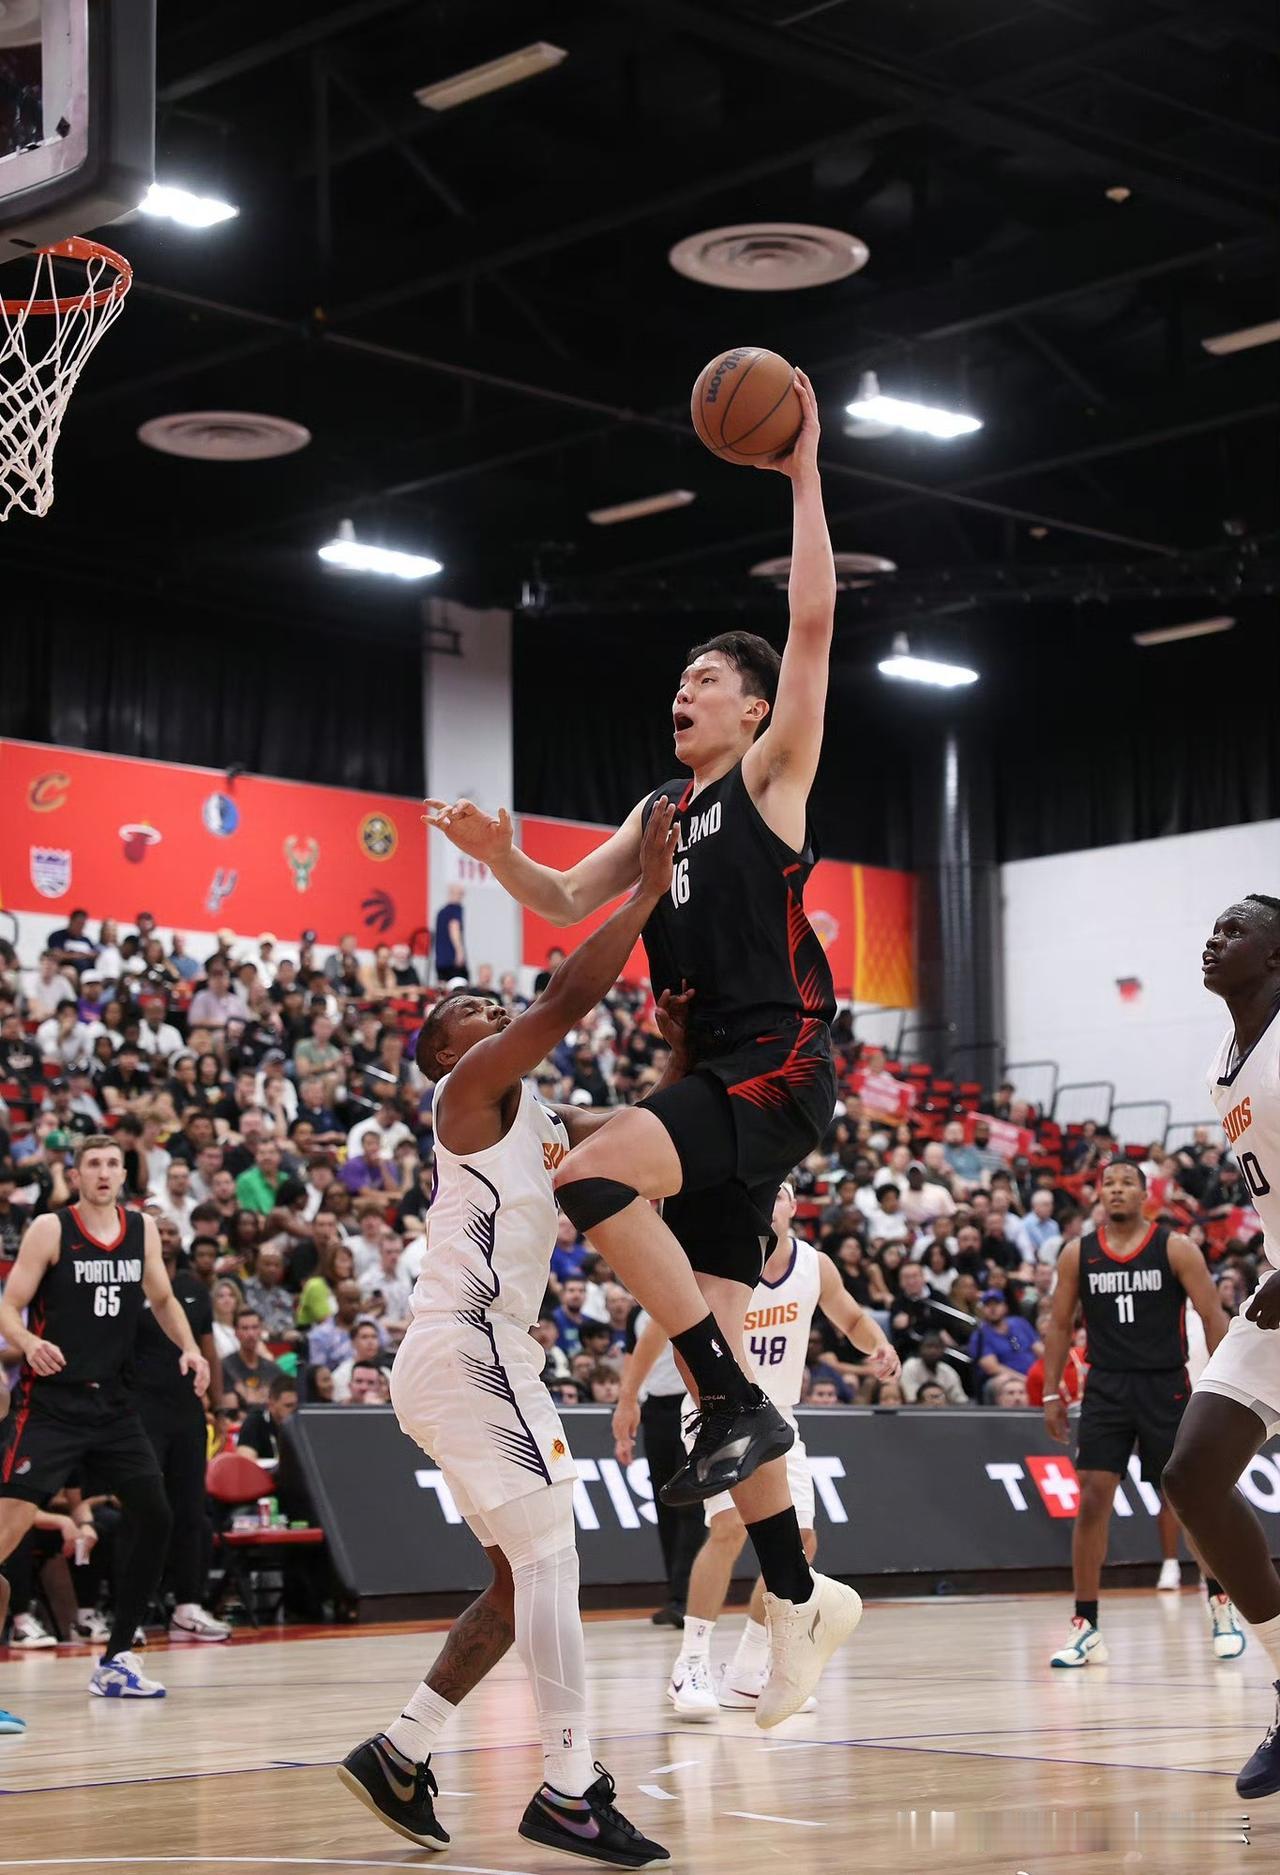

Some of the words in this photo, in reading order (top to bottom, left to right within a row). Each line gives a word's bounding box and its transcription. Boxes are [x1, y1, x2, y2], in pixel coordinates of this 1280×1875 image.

[666, 801, 721, 854] LAND
[671, 858, 690, 909] 16
[1236, 1151, 1271, 1198] 0
[73, 1259, 142, 1284] PORTLAND
[1088, 1269, 1162, 1295] PORTLAND
[94, 1285, 121, 1317] 65
[1115, 1294, 1135, 1324] 11
[750, 1336, 787, 1366] 48
